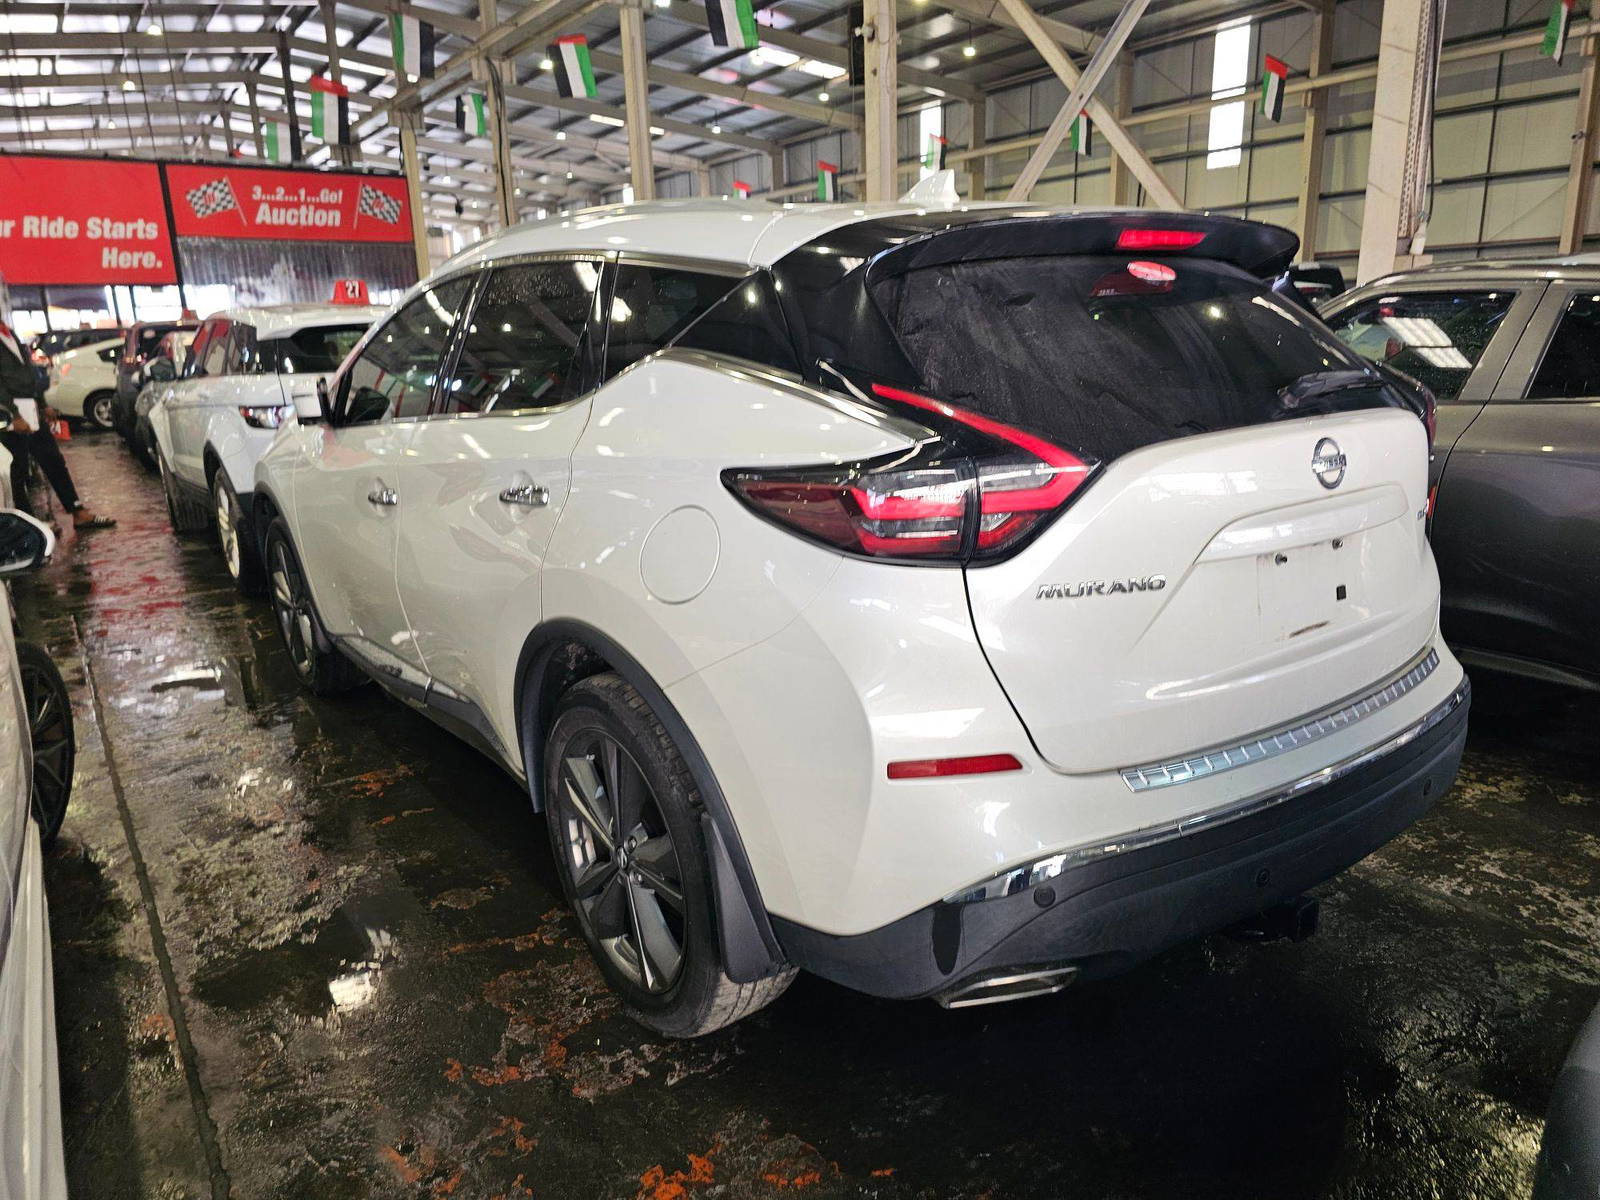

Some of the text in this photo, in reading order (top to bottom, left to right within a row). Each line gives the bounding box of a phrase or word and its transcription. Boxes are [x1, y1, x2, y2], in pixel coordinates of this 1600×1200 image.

[255, 202, 341, 227] Auction
[22, 215, 79, 239] Ride
[86, 216, 158, 240] Starts
[101, 247, 162, 269] Here.
[1036, 574, 1166, 600] MURANO
